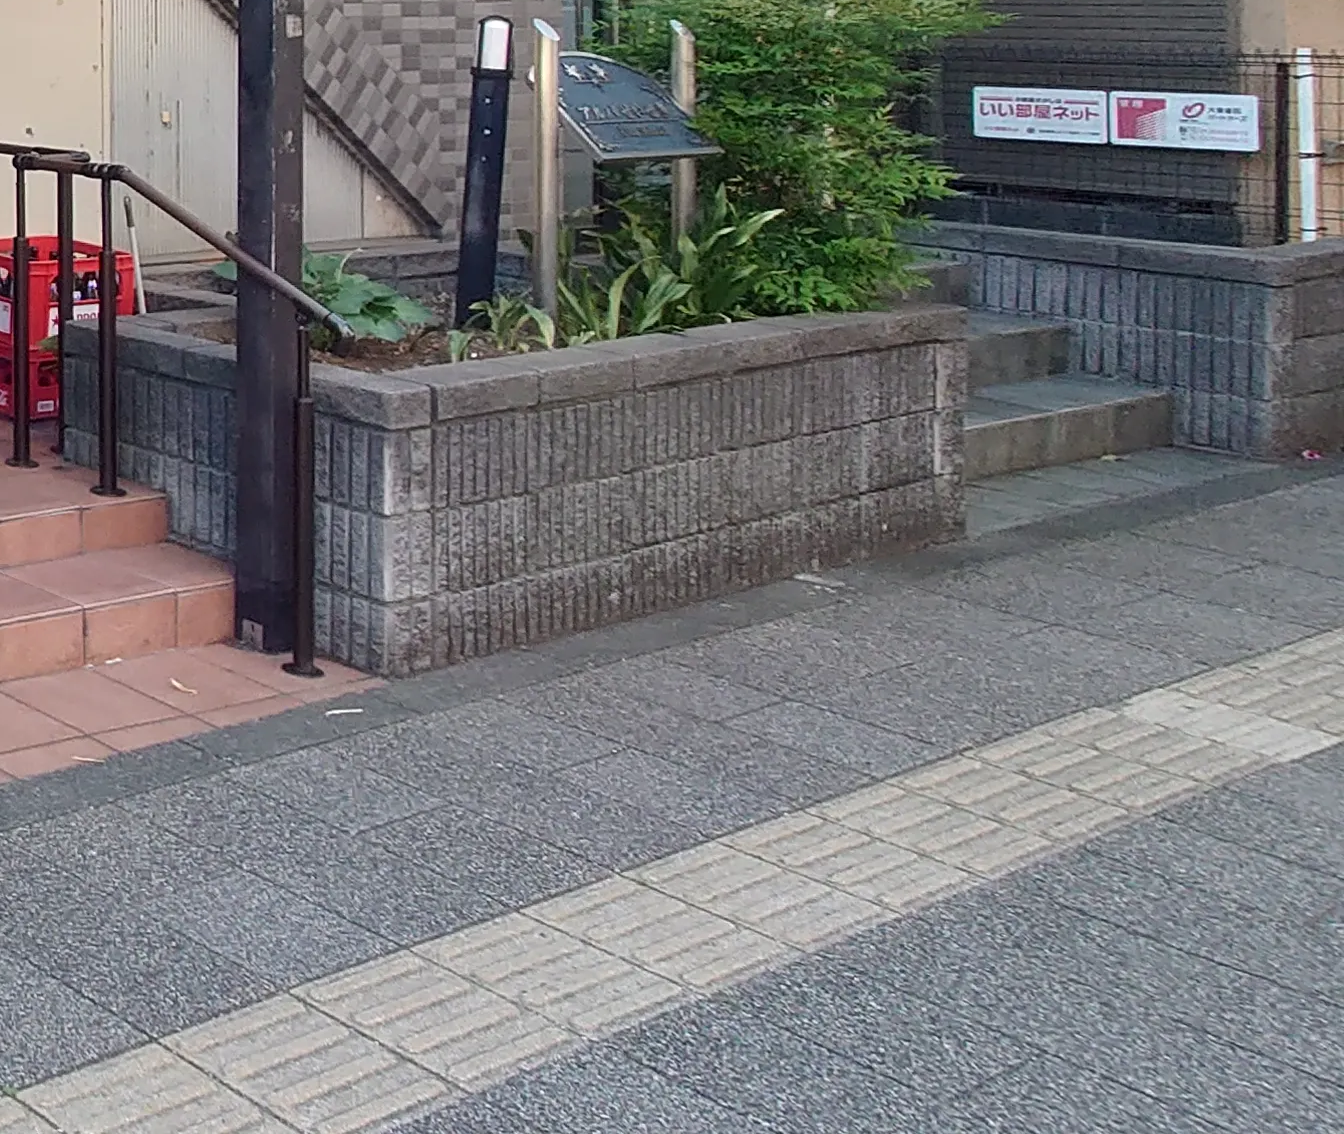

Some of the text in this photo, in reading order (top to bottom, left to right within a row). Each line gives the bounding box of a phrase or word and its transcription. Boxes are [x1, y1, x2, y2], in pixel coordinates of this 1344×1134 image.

[979, 102, 1100, 122] いい部屋ネット
